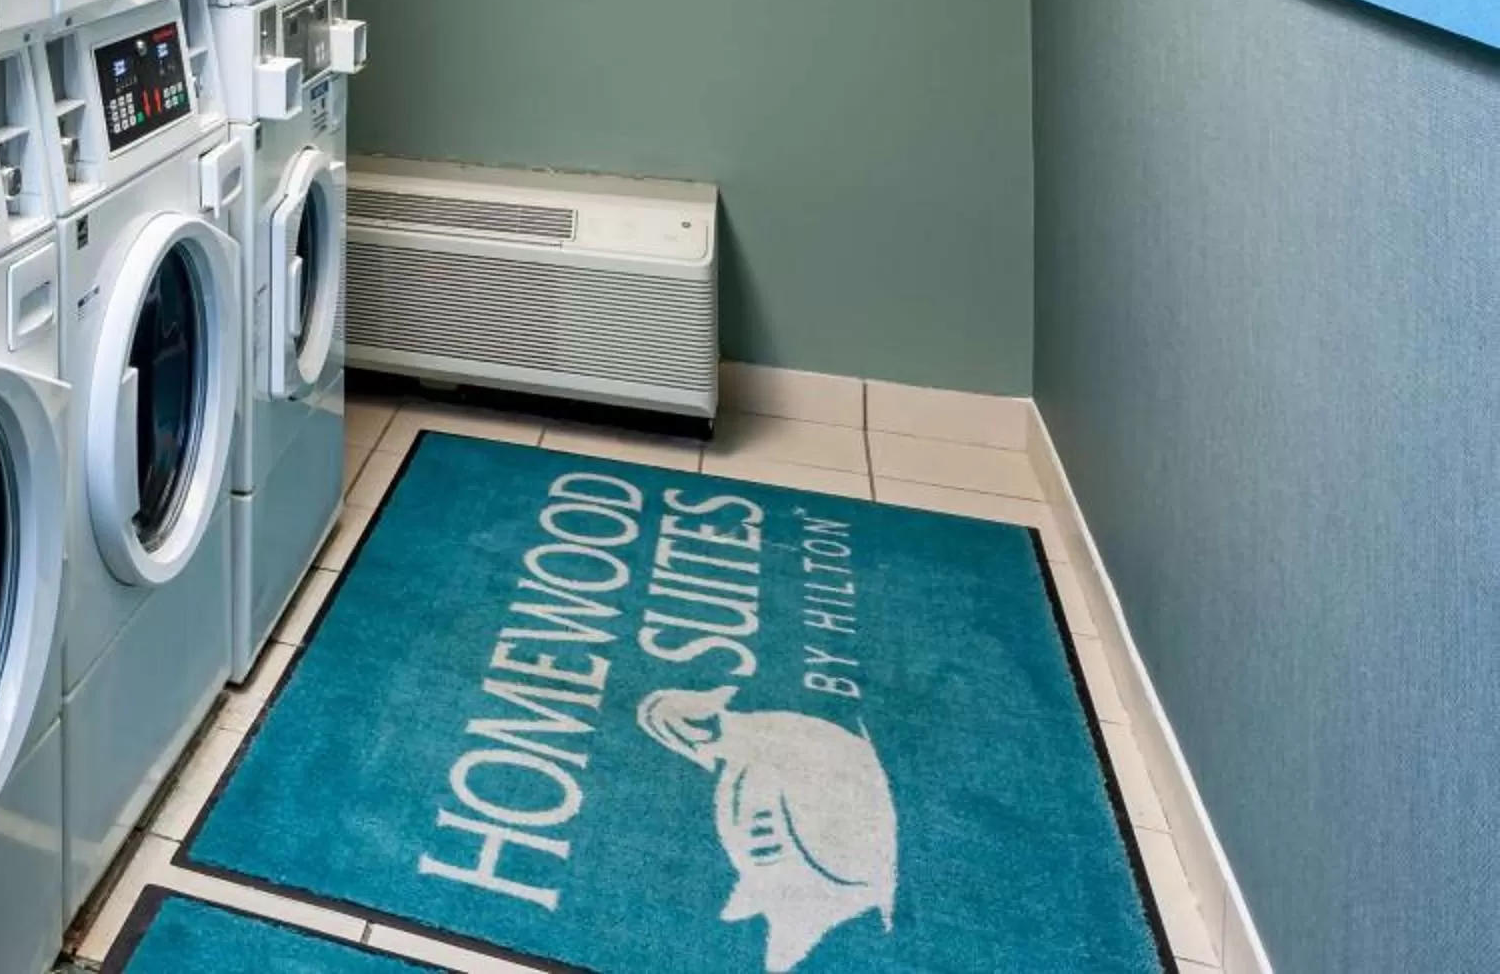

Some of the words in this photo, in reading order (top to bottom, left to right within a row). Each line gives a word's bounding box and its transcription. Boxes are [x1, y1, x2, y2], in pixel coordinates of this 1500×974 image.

[638, 488, 763, 676] SUITES
[803, 516, 857, 635] HILTON
[418, 472, 643, 912] HOMEWOOD
[803, 645, 861, 699] BY
